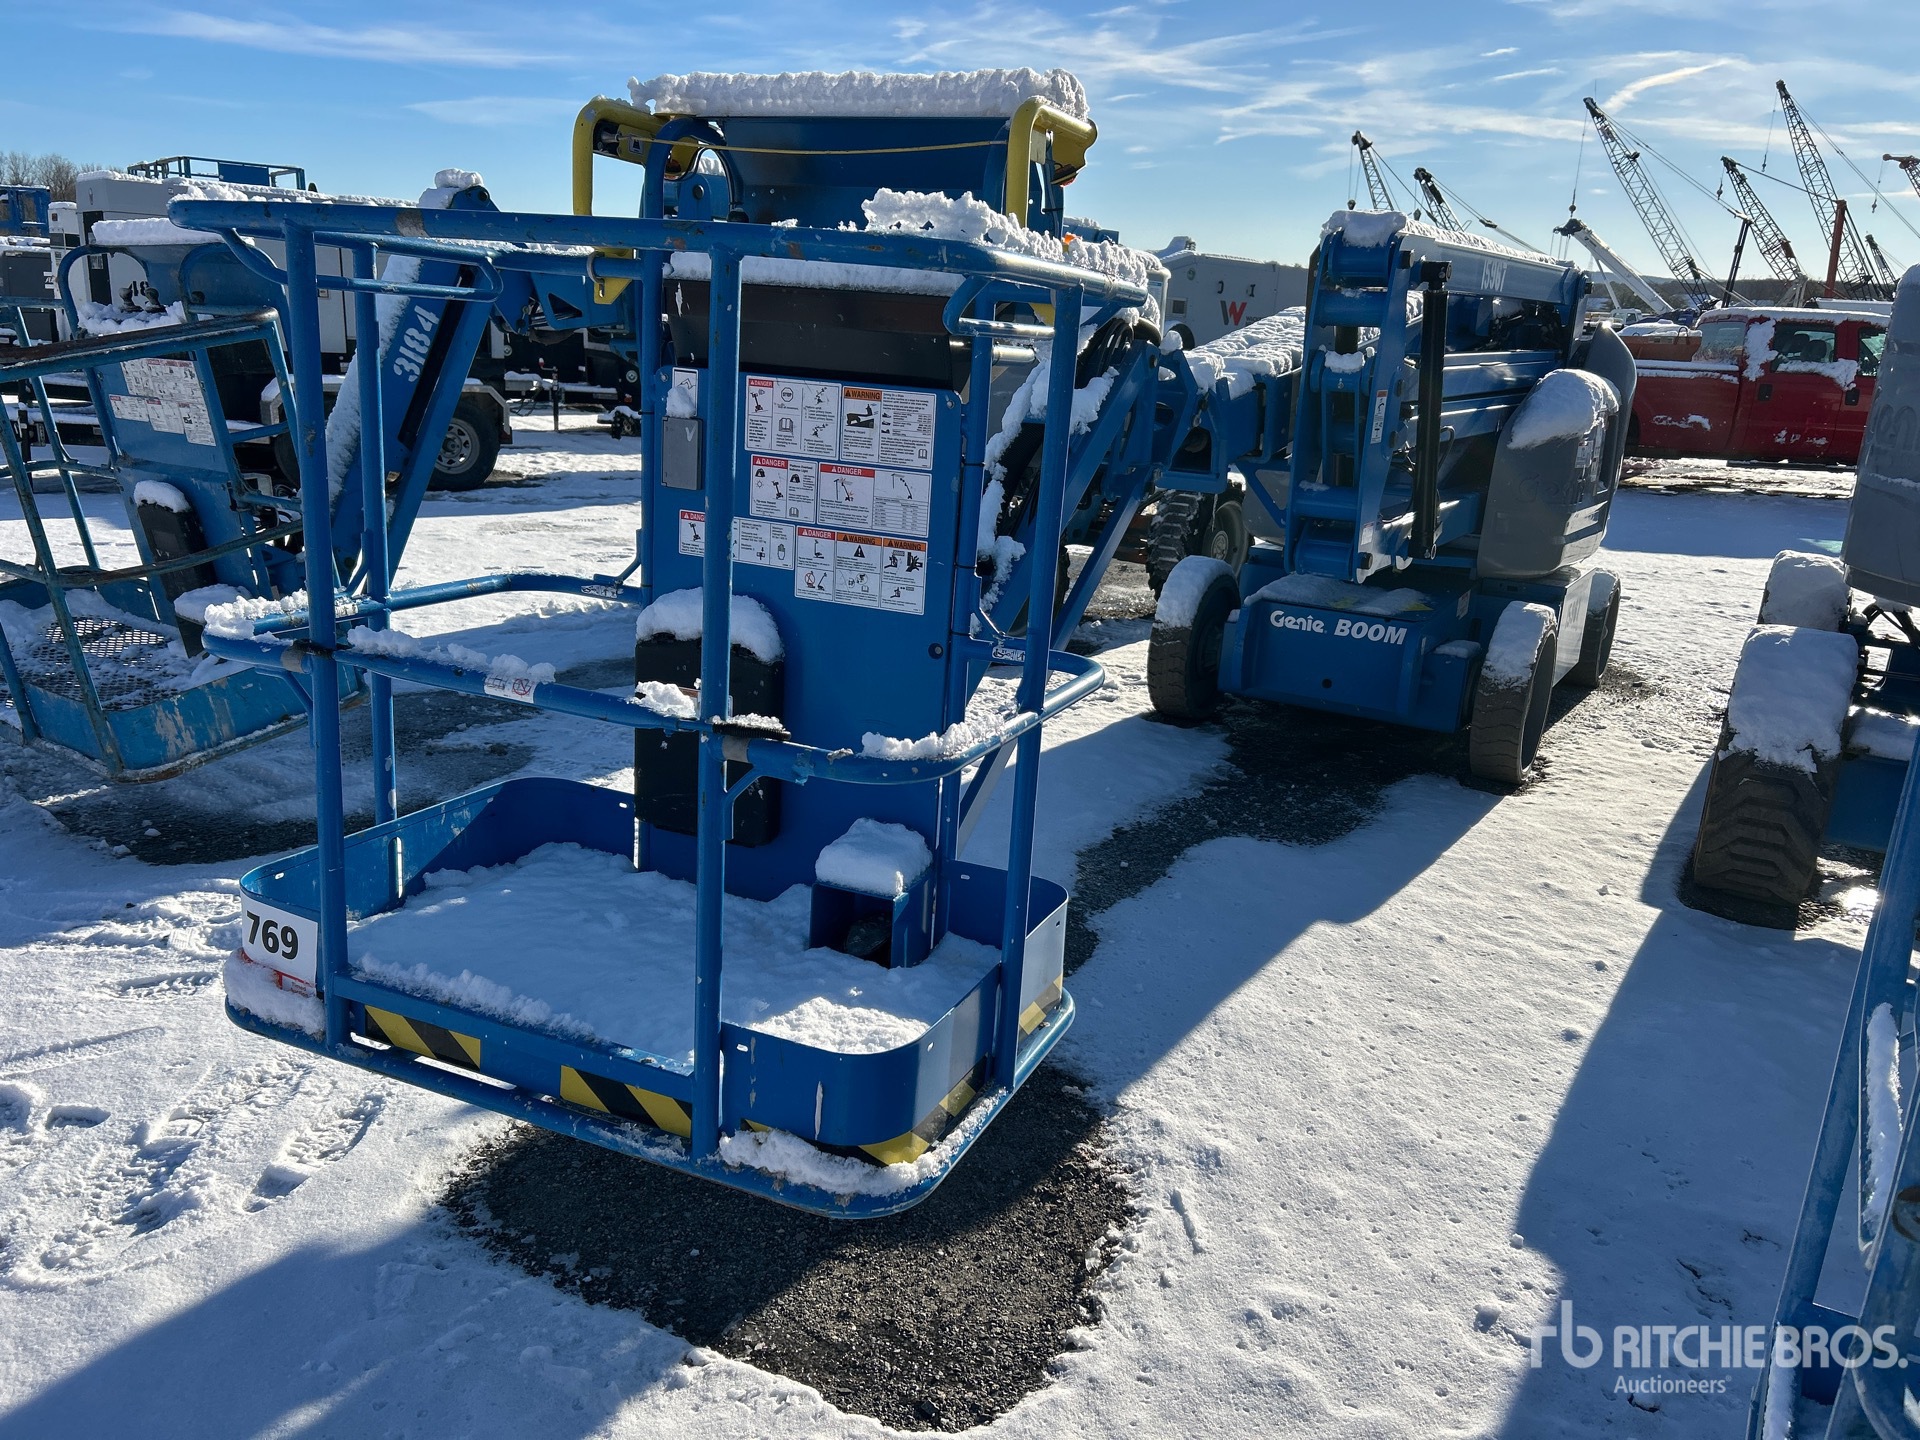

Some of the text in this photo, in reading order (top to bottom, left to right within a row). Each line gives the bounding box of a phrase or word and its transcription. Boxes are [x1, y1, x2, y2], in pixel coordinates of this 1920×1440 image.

[393, 304, 440, 382] 3184
[754, 379, 773, 388] DANGER
[851, 390, 880, 400] WARNING
[761, 457, 785, 468] DANGER
[837, 466, 862, 476] DANGER
[690, 513, 705, 521] DANG
[807, 530, 832, 539] DANGER
[848, 534, 876, 545] WARNING
[893, 539, 922, 550] WARNING
[1270, 610, 1407, 645] Genie BOOM
[247, 910, 299, 960] 769
